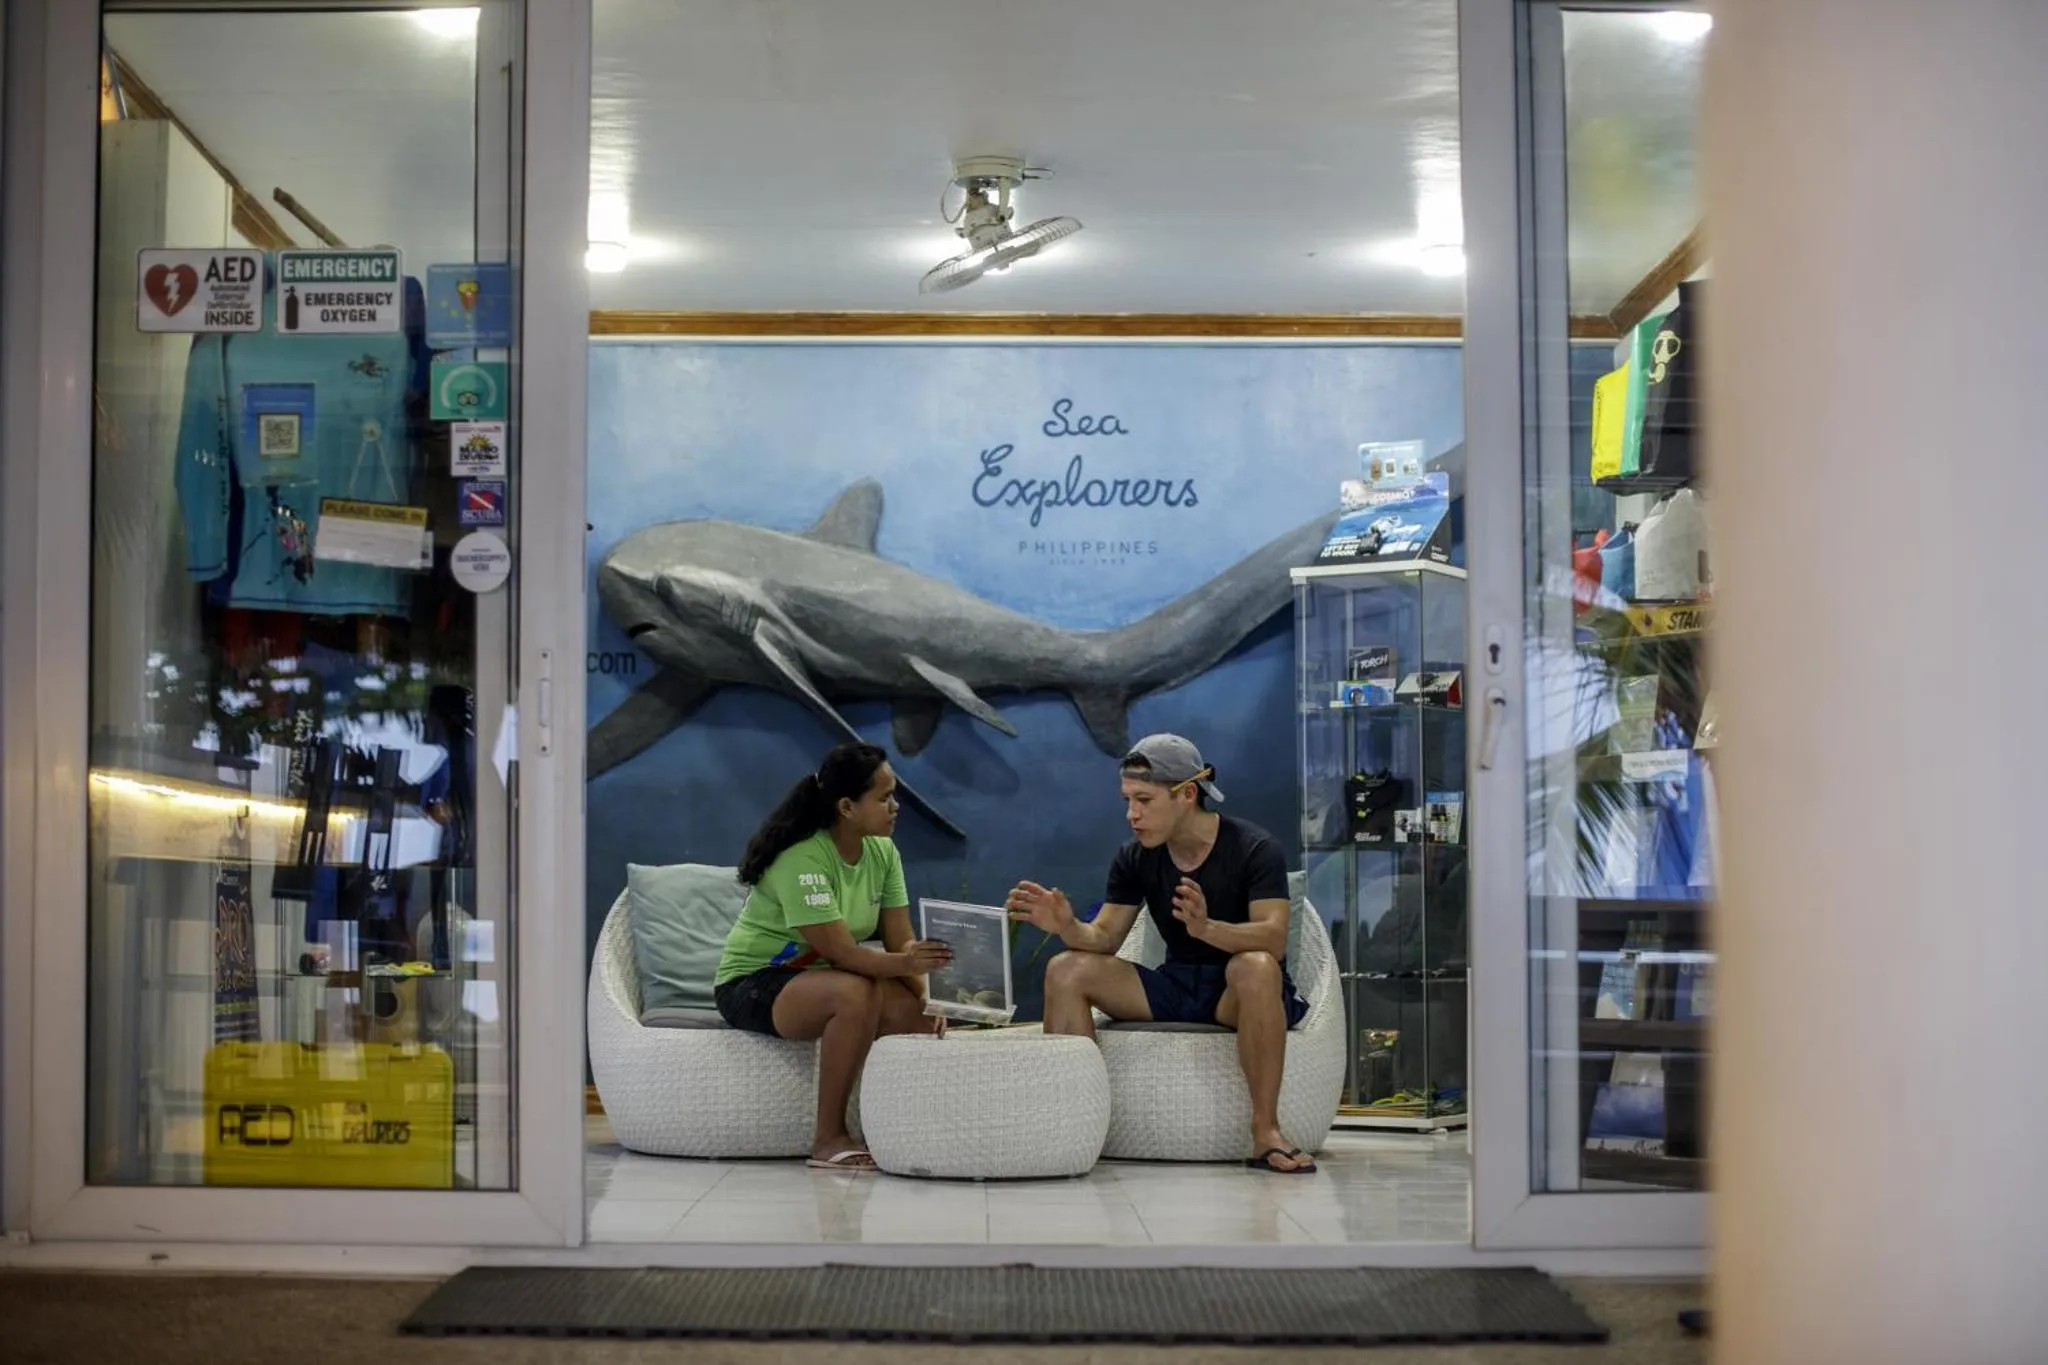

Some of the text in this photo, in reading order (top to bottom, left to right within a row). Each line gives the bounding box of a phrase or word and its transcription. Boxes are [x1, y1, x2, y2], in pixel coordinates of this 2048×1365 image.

[204, 256, 257, 283] AED
[283, 258, 395, 278] EMERGENCY
[304, 292, 393, 306] EMERGENCY
[204, 310, 255, 326] INSIDE
[320, 308, 377, 323] OXYGEN
[1042, 398, 1129, 437] Sea
[971, 443, 1199, 527] Explorers
[1018, 540, 1158, 555] PHILIPPINES
[1360, 654, 1389, 670] TORCH
[219, 1104, 295, 1145] AED
